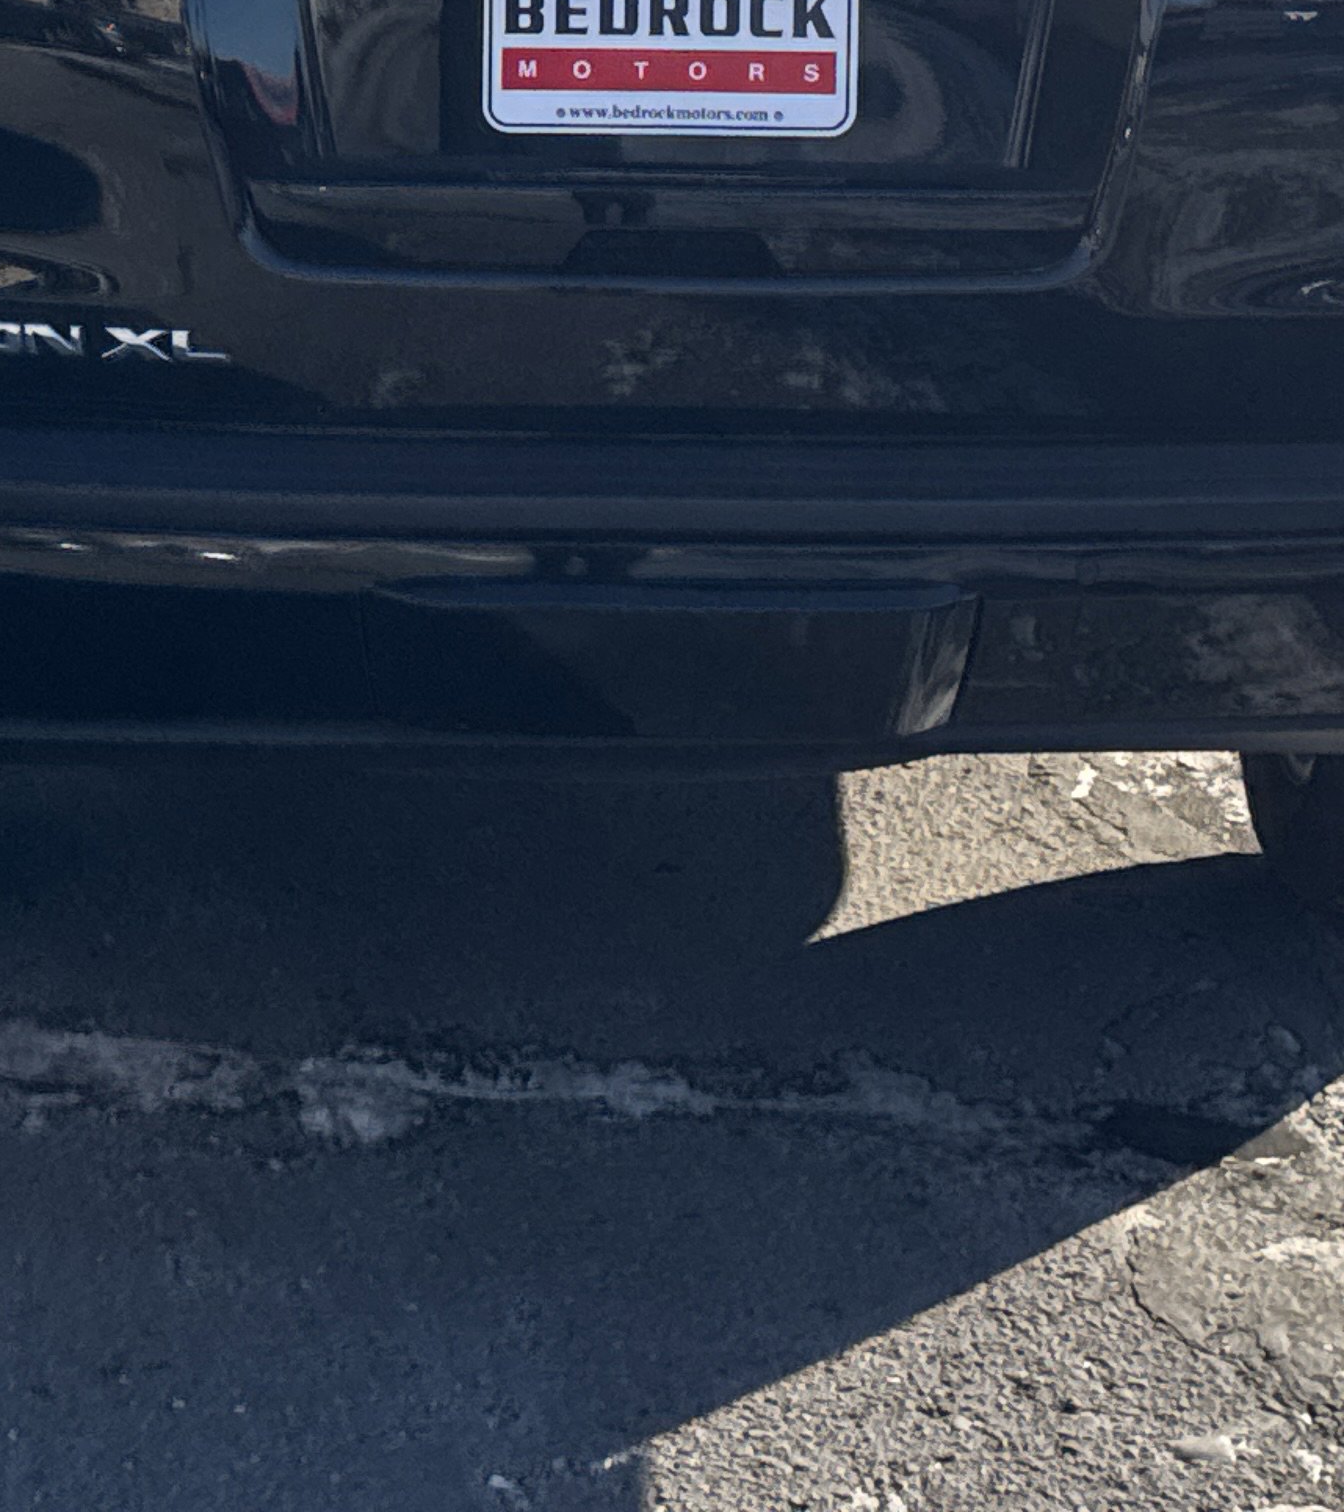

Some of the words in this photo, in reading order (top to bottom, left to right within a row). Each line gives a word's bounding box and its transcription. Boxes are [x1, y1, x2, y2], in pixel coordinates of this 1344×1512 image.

[517, 59, 821, 83] MOTORS
[569, 105, 769, 122] www.bedrockmotors.com
[101, 326, 231, 362] XL
